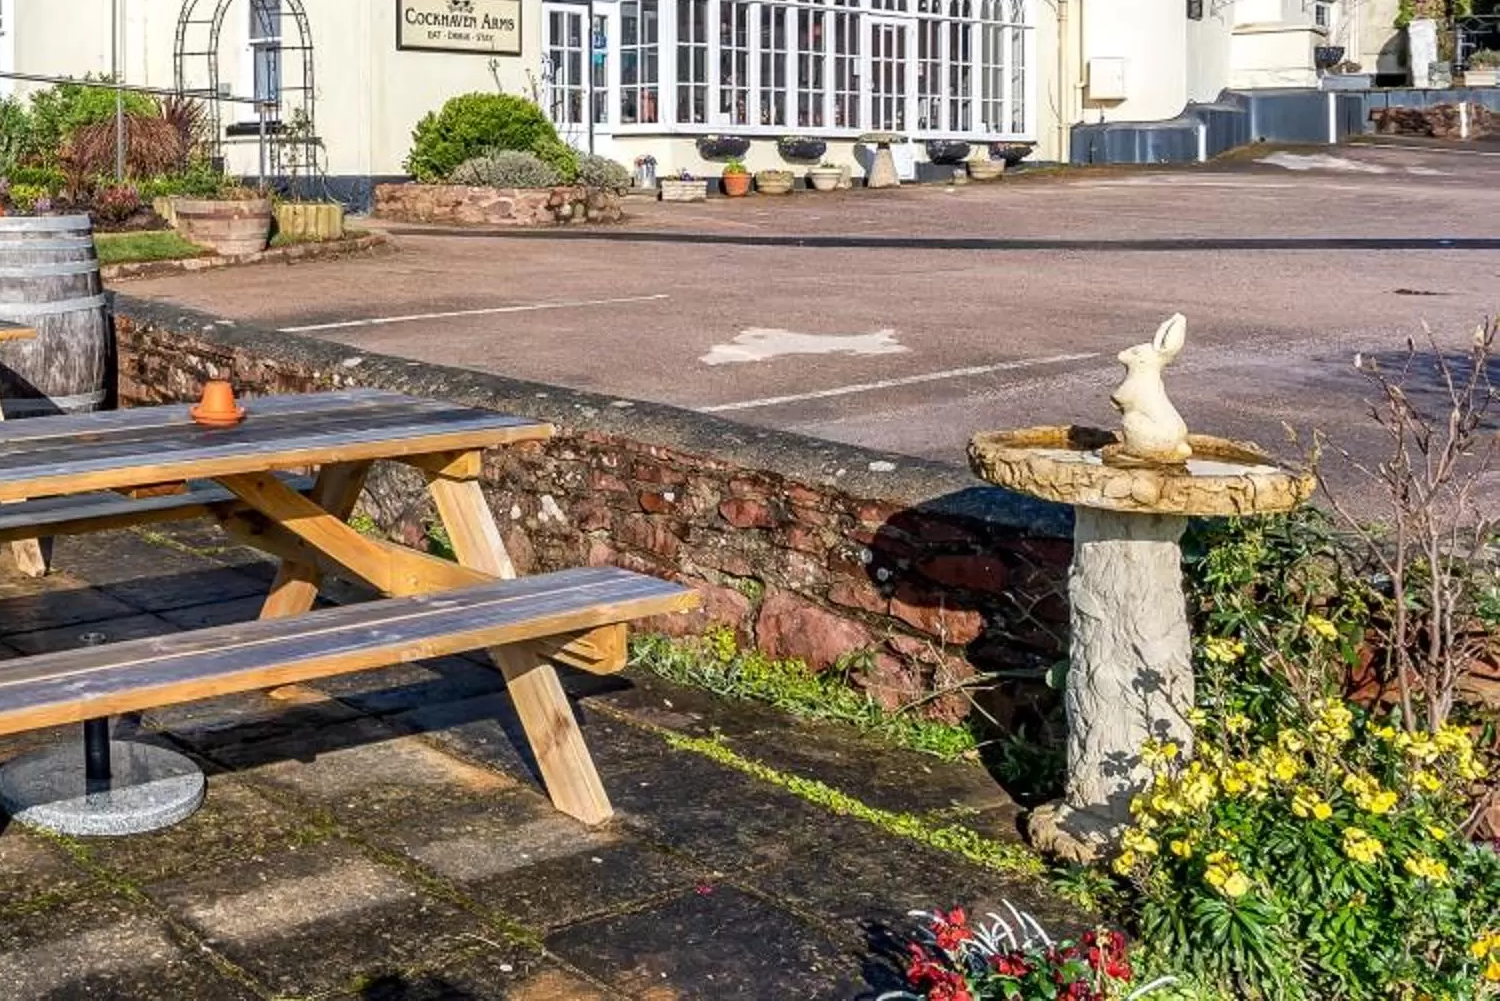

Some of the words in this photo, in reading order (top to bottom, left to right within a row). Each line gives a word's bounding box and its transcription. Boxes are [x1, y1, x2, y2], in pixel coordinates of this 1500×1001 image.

[405, 7, 477, 29] COCKHAVEN
[481, 13, 515, 32] ARMS
[427, 30, 442, 39] EAT
